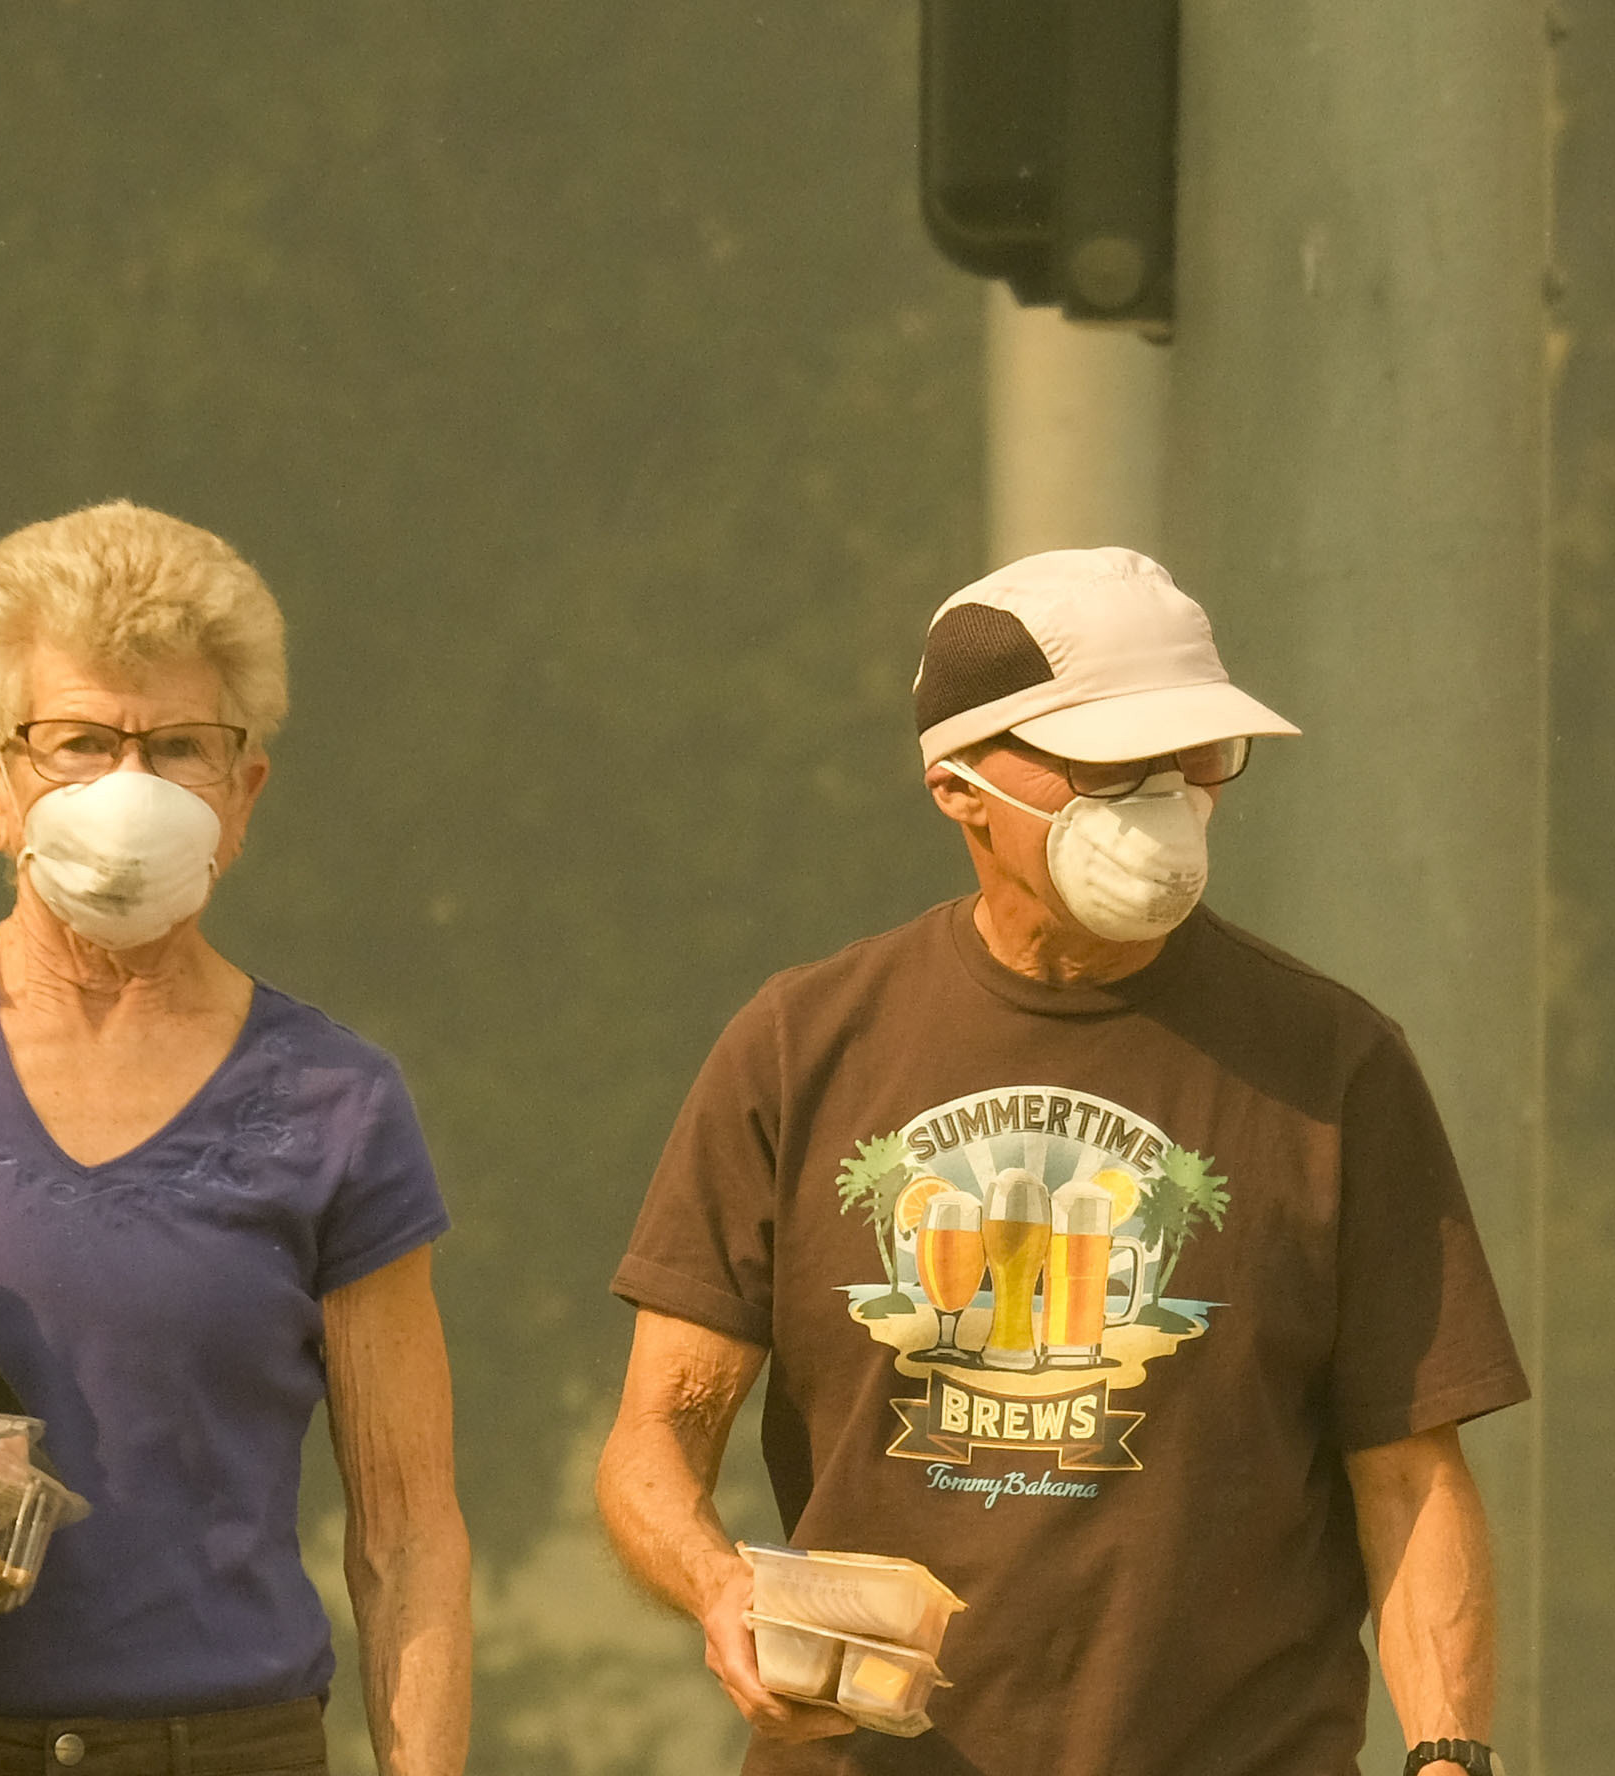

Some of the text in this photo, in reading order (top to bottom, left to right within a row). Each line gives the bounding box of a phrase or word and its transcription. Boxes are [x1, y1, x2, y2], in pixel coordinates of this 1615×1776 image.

[906, 1094, 1164, 1174] SUMMERTIME
[940, 1383, 1097, 1441] BREWS
[926, 1463, 1099, 1509] Tommy Bahama
